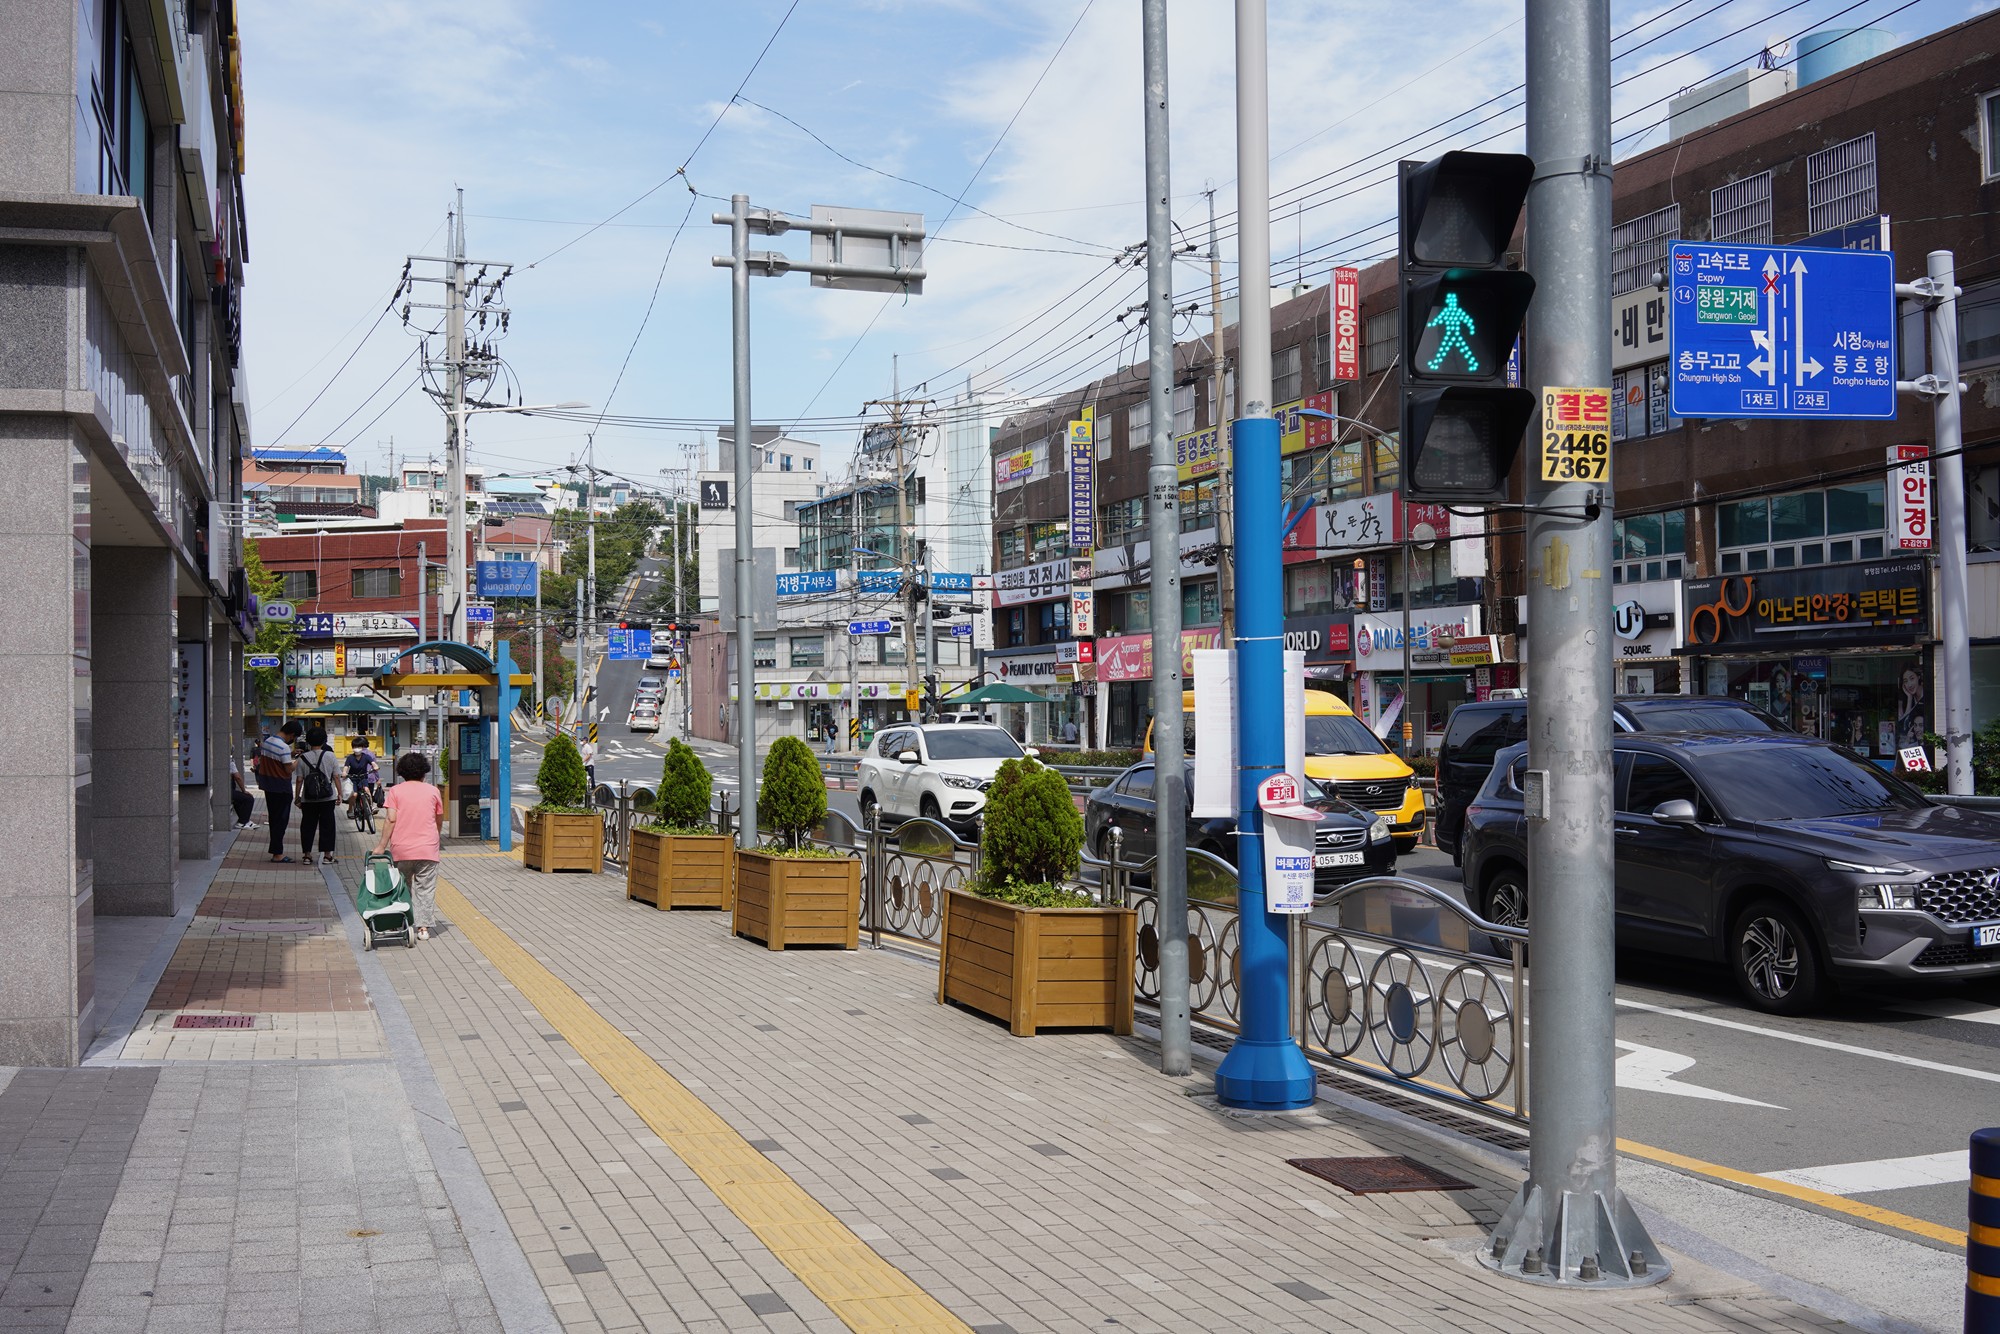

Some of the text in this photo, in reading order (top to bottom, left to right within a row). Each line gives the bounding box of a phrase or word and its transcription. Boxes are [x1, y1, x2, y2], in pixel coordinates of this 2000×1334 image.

[1678, 261, 1690, 272] 35
[1697, 252, 1750, 271] 고속도로
[1697, 273, 1725, 284] Expwy
[1678, 289, 1691, 300] 14
[1699, 310, 1756, 322] Changwon Geoje
[1337, 283, 1356, 363] 미용실
[1833, 331, 1862, 350] 시청
[1862, 339, 1889, 350] City Hall
[1678, 350, 1741, 371] 충무고교
[1678, 373, 1741, 384] Chungmu High Sch
[1833, 377, 1863, 387] Dongho
[1745, 393, 1774, 406] 1차로
[1797, 393, 1825, 407] 2차로
[1556, 394, 1608, 421] 결혼
[1546, 433, 1607, 455] 2446
[1546, 456, 1606, 479] 7367
[1903, 477, 1927, 536] 안경
[484, 565, 529, 579] 중앙로
[811, 576, 833, 588] 사무소
[940, 577, 967, 589] 사무소
[266, 606, 289, 616] CU
[1074, 600, 1090, 614] PC
[1284, 630, 1320, 650] ORLD
[1121, 641, 1140, 656] Supreme
[1623, 645, 1651, 656] SQUARE
[1009, 663, 1033, 676] PEARLY
[1276, 857, 1310, 869] 벼룩시장
[1339, 853, 1359, 863] 3785
